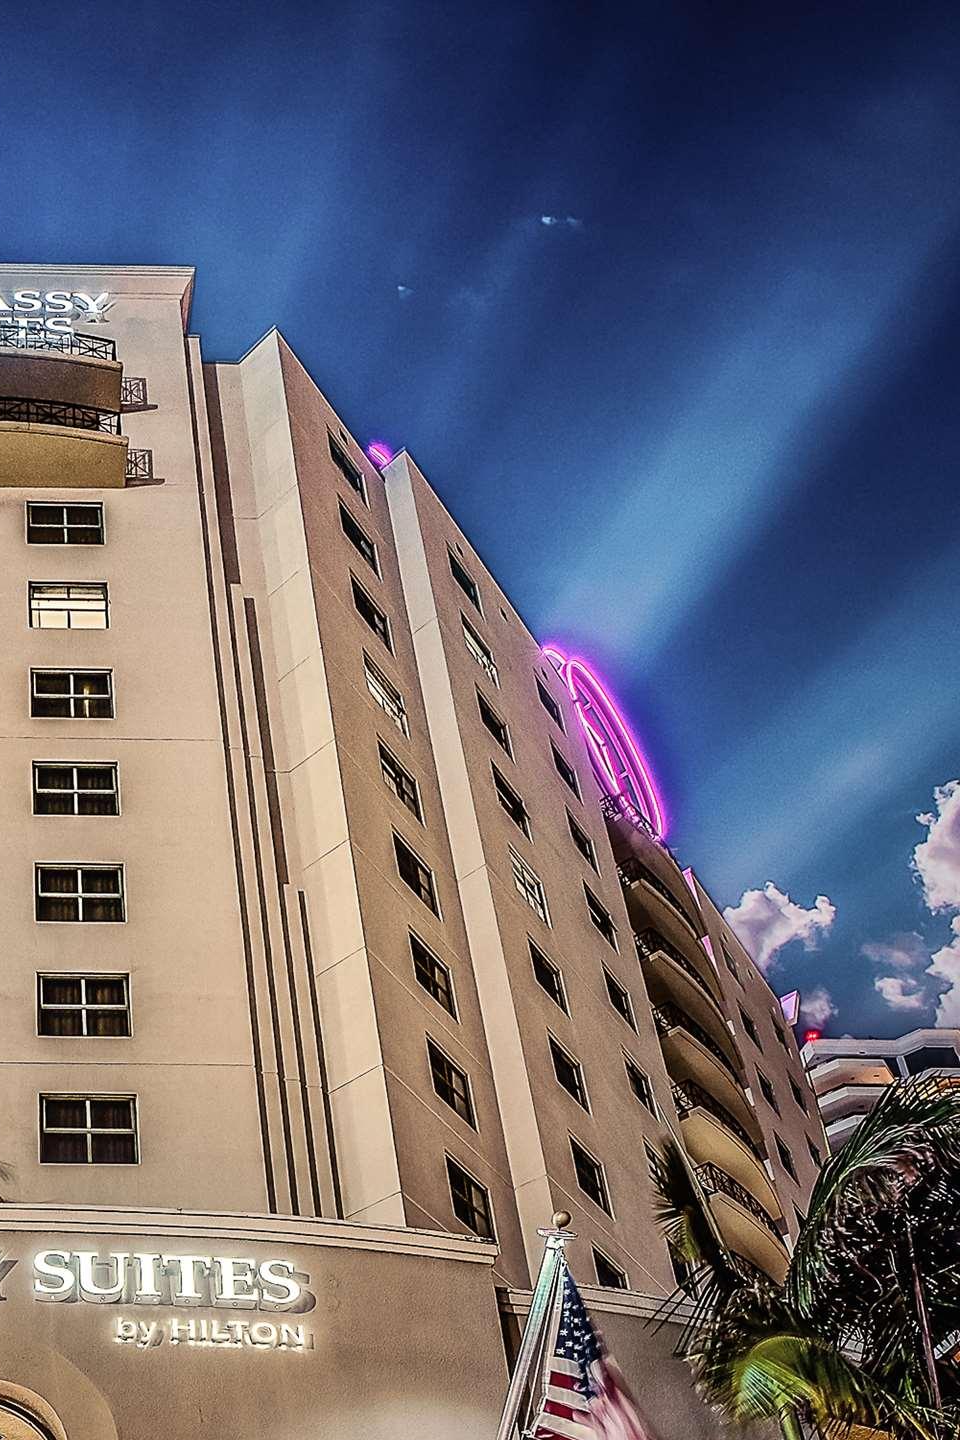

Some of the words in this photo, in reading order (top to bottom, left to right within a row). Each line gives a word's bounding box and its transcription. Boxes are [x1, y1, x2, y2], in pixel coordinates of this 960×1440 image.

[32, 1249, 303, 1305] SUITES
[116, 1317, 159, 1348] by
[170, 1319, 306, 1349] HILTON
